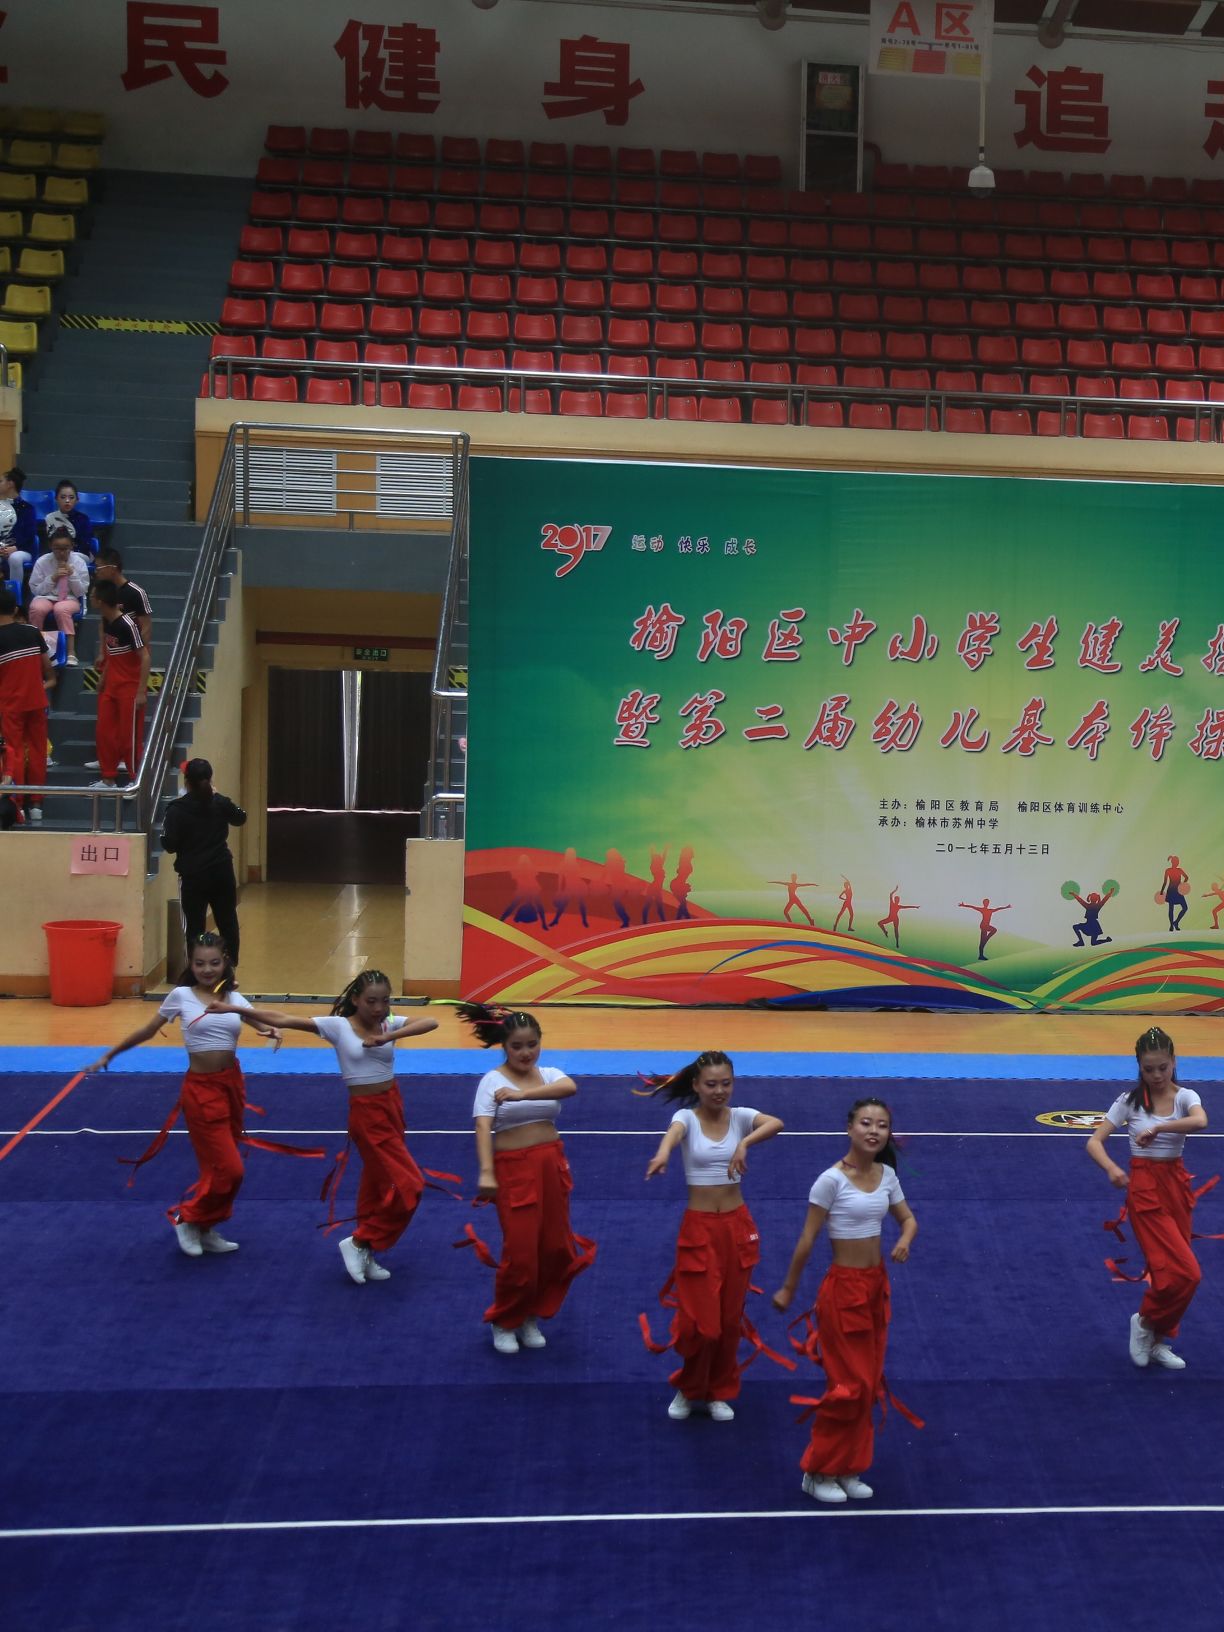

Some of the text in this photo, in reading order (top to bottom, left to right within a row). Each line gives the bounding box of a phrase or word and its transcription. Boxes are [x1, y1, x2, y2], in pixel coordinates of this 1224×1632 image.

[887, 1, 976, 43] A区
[632, 534, 757, 555] 运动 快乐 成长
[1017, 801, 1124, 814] 榆阳区体育训练中心
[81, 844, 119, 862] 出口
